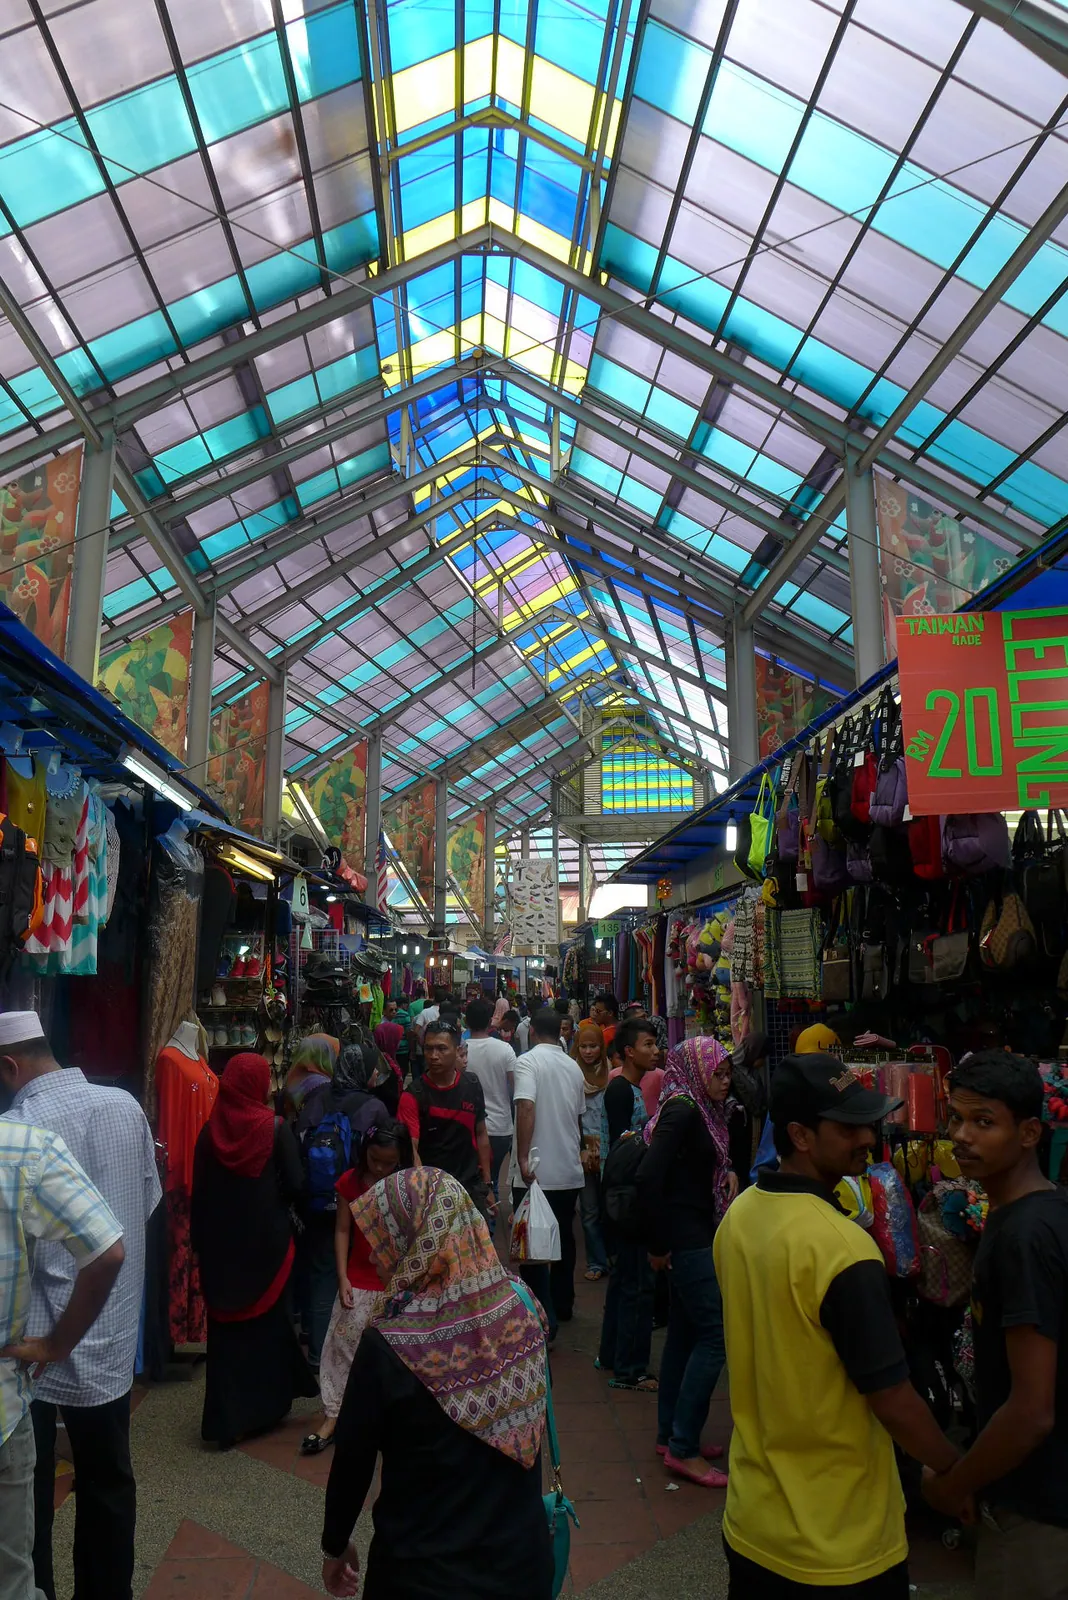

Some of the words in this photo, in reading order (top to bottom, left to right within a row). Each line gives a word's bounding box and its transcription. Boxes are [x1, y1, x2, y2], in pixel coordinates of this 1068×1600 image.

[904, 614, 984, 635] TAIWAN
[952, 634, 982, 646] MADE
[904, 729, 935, 762] RM
[925, 687, 1002, 777] 20
[300, 885, 306, 906] 6
[601, 923, 619, 933] 135
